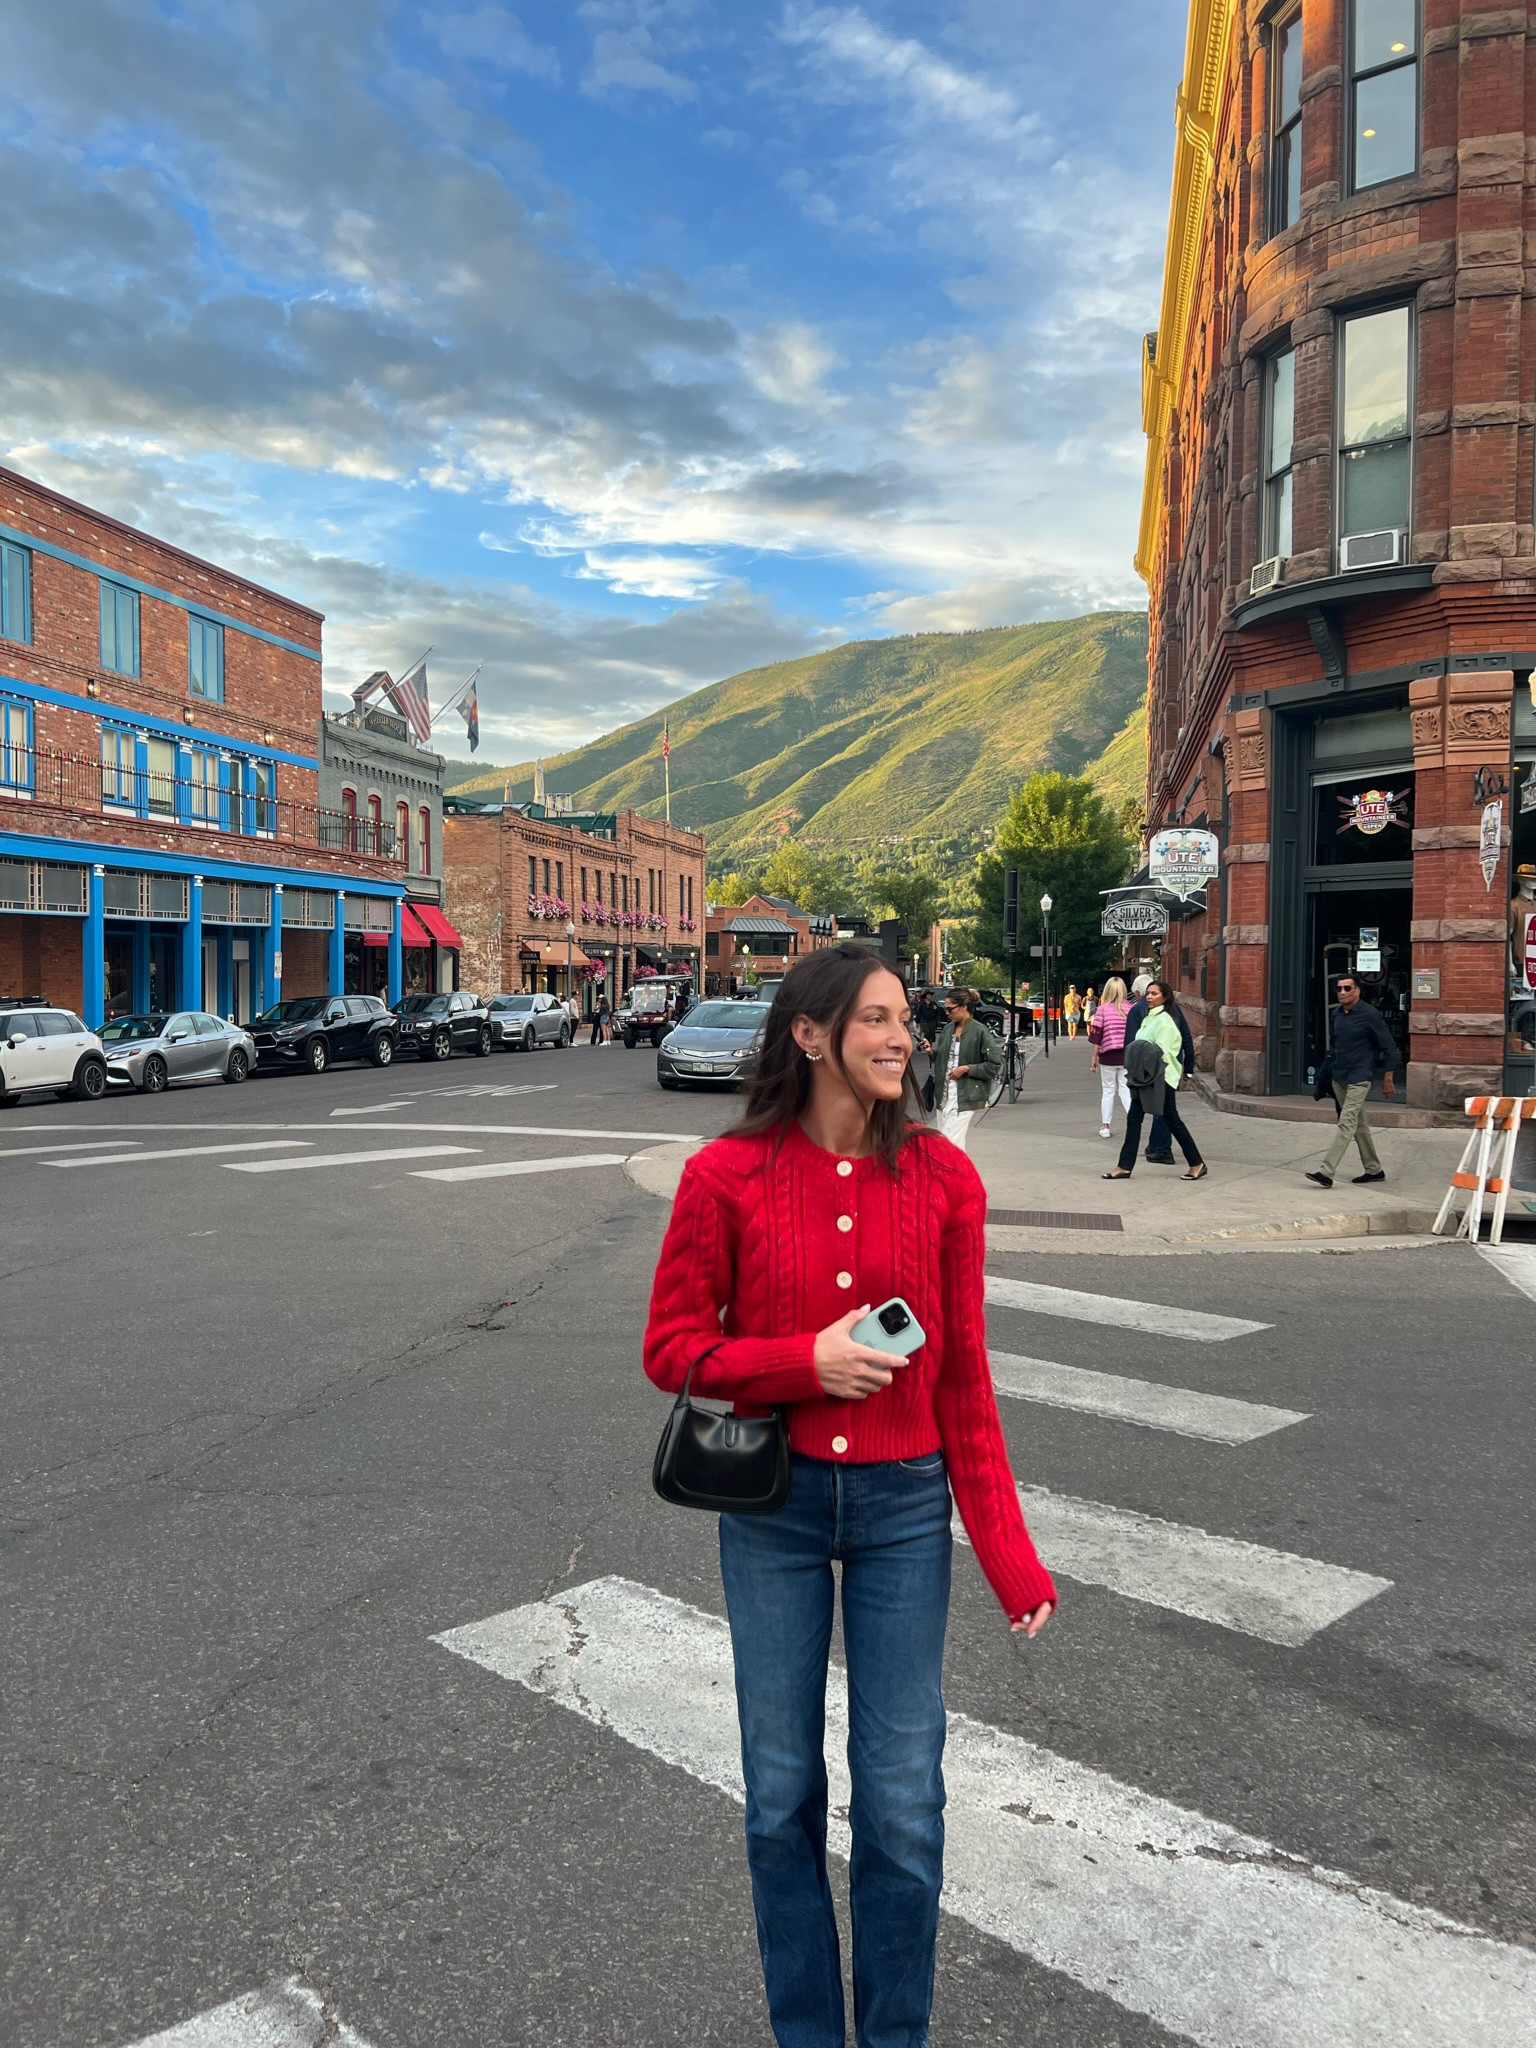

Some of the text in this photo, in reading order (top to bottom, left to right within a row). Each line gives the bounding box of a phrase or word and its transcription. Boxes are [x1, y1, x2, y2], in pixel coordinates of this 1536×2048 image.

[1361, 803, 1384, 814] UTE
[1351, 814, 1395, 823] MOUNTAINEER
[1168, 852, 1199, 863] UTE
[1120, 907, 1151, 918] SILVER
[1124, 918, 1147, 929] CITY
